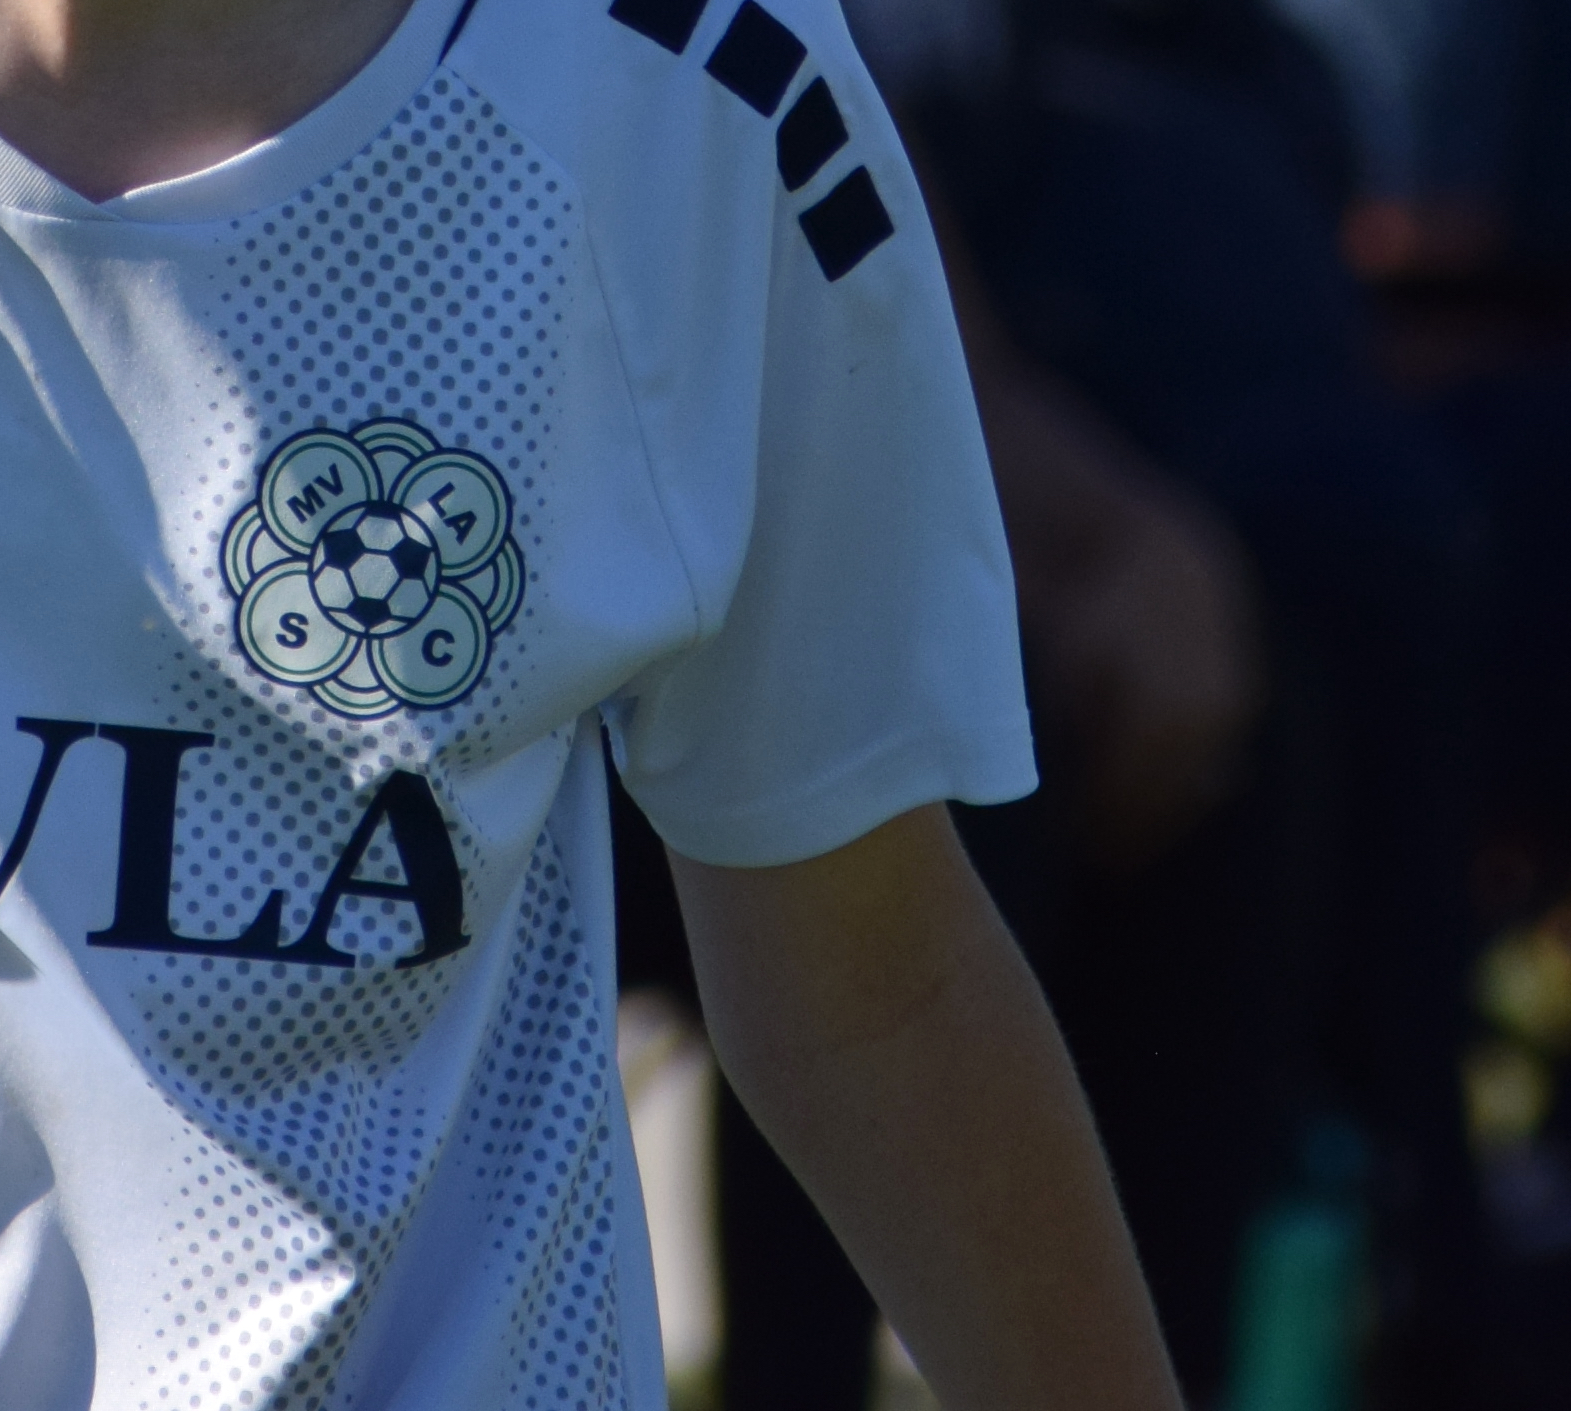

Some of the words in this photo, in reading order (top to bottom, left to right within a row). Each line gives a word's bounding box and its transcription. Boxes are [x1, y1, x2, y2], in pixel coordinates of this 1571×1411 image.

[286, 462, 345, 524] MV
[427, 481, 478, 546] LA
[275, 611, 310, 650] S
[420, 628, 456, 668] C
